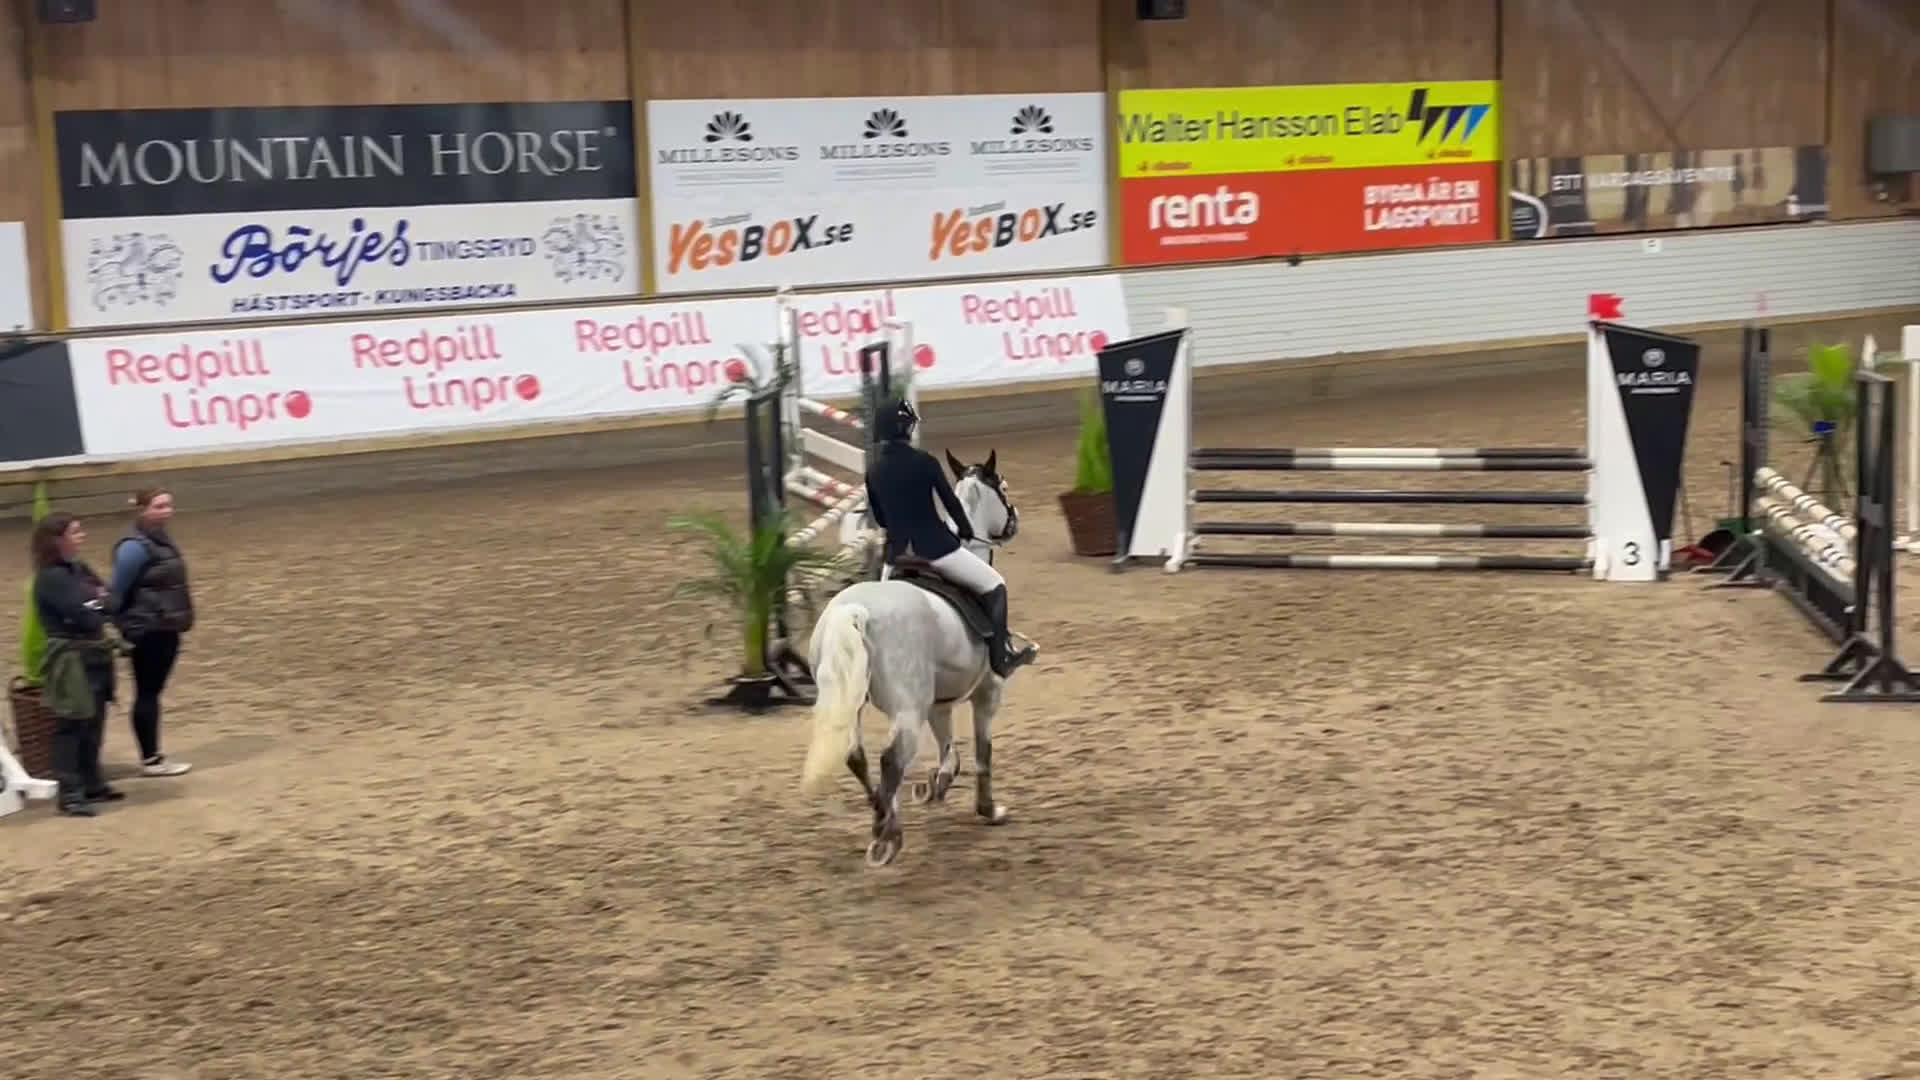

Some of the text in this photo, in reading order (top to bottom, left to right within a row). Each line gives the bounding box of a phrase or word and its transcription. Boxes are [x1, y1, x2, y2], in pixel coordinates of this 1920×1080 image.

[1119, 104, 1402, 143] Walter Hansson Elab
[77, 129, 603, 187] MOUNTAIN HORSE
[657, 146, 800, 164] MILLESONS
[819, 141, 952, 160] MILLESONS
[969, 137, 1094, 155] MILLESONS
[1149, 185, 1260, 230] renta
[1364, 183, 1424, 205] BYGGA
[1454, 180, 1480, 199] EN
[211, 218, 537, 287] Börjes TINGSRYD
[375, 284, 517, 305] KUNGSBACKA
[962, 287, 1078, 328] Redpill
[574, 311, 712, 356] Redpill
[794, 290, 896, 341] edpill
[106, 339, 270, 387] Redpill
[351, 323, 503, 371] Redpill
[1002, 328, 1108, 363] Linpro
[403, 371, 540, 411] Linpro
[623, 355, 748, 395] Linpro
[1102, 379, 1167, 394] MARIA
[1617, 371, 1693, 385] MARIA
[163, 388, 312, 431] Linpro
[1623, 541, 1640, 566] 3
